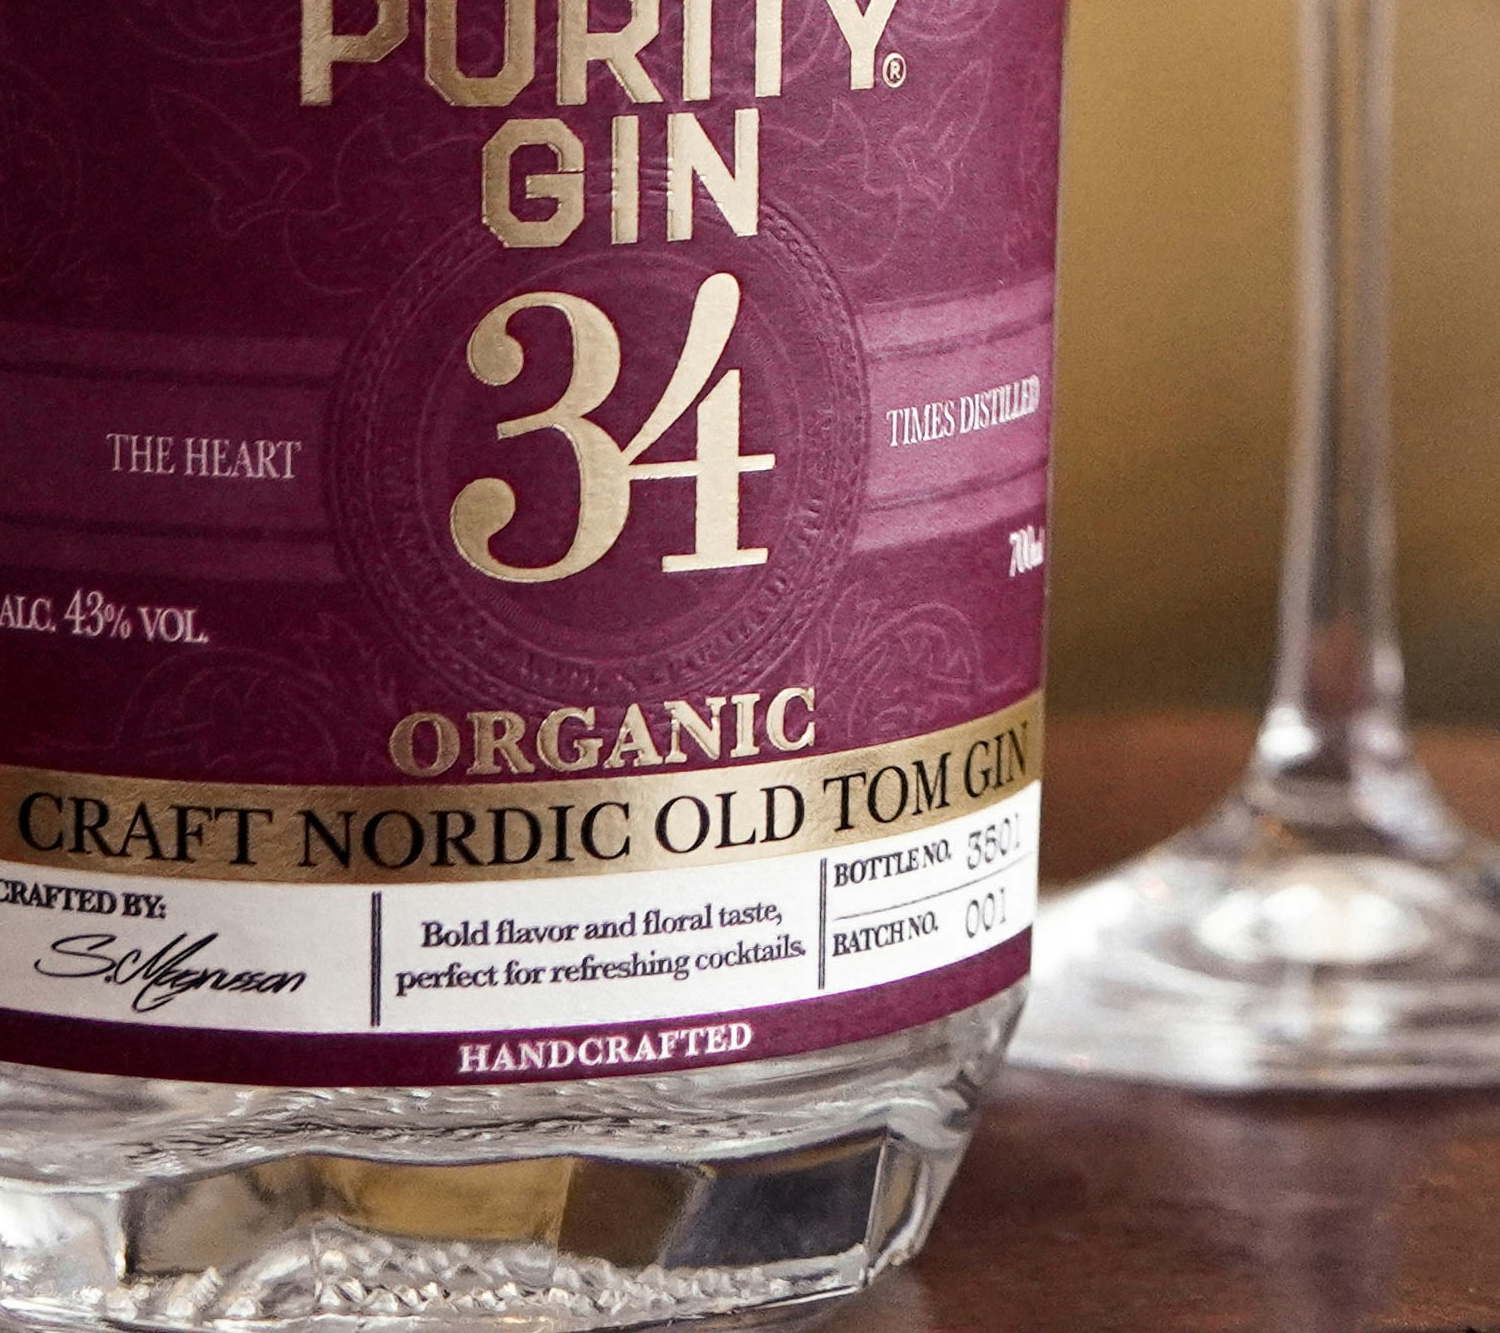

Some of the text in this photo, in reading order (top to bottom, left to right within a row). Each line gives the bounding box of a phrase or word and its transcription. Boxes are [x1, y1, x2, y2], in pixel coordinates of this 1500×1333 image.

[482, 108, 760, 248] GIN
[449, 271, 777, 584] 34
[886, 374, 1041, 447] TIMES DISTILLED
[106, 433, 302, 480] THE HEART
[63, 587, 132, 640] 43%
[137, 606, 209, 644] VOL.
[388, 686, 816, 777] ORGANIC
[18, 721, 1031, 870] CRAFT NORDIC OLD TOM GIN
[834, 848, 919, 888] BOTTLE
[922, 839, 952, 868] NO.
[122, 892, 167, 920] BY:
[421, 900, 783, 948] Bold flavor and floral taste,
[832, 887, 1007, 957] BATCH NO. 001
[395, 933, 807, 997] perfect for refreshing cocktails.
[458, 1021, 753, 1075] HANDCRAFTED
